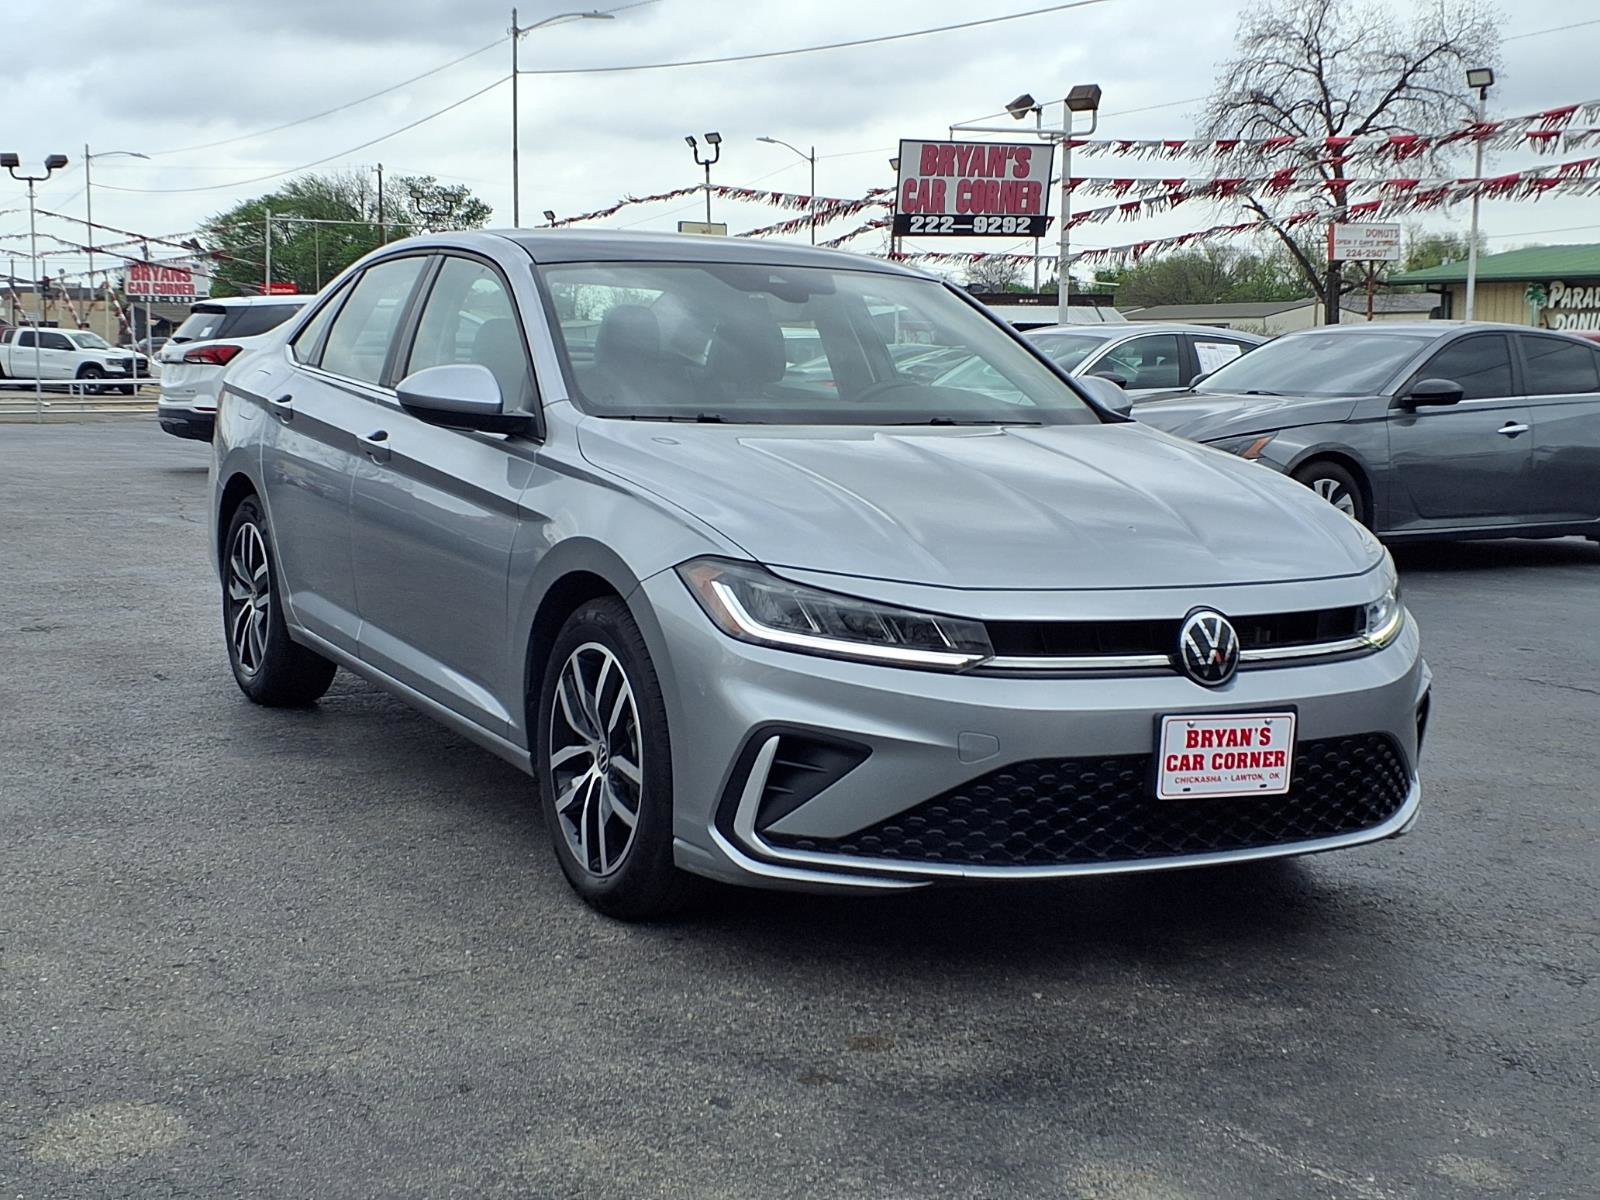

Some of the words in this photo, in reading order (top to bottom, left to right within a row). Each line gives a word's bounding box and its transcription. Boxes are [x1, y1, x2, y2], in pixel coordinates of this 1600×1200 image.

[919, 144, 1032, 179] BRYAN'S
[901, 178, 947, 214] CAR
[955, 178, 1043, 215] CORNER
[909, 215, 1031, 234] 222-9292
[128, 282, 150, 294] CAR
[153, 283, 195, 295] CORNER
[1185, 727, 1271, 749] BRYAN'S
[1166, 754, 1205, 772] CAR
[1211, 750, 1285, 771] CORNER
[1174, 775, 1222, 784] CHICKASHA
[1268, 772, 1280, 780] OK
